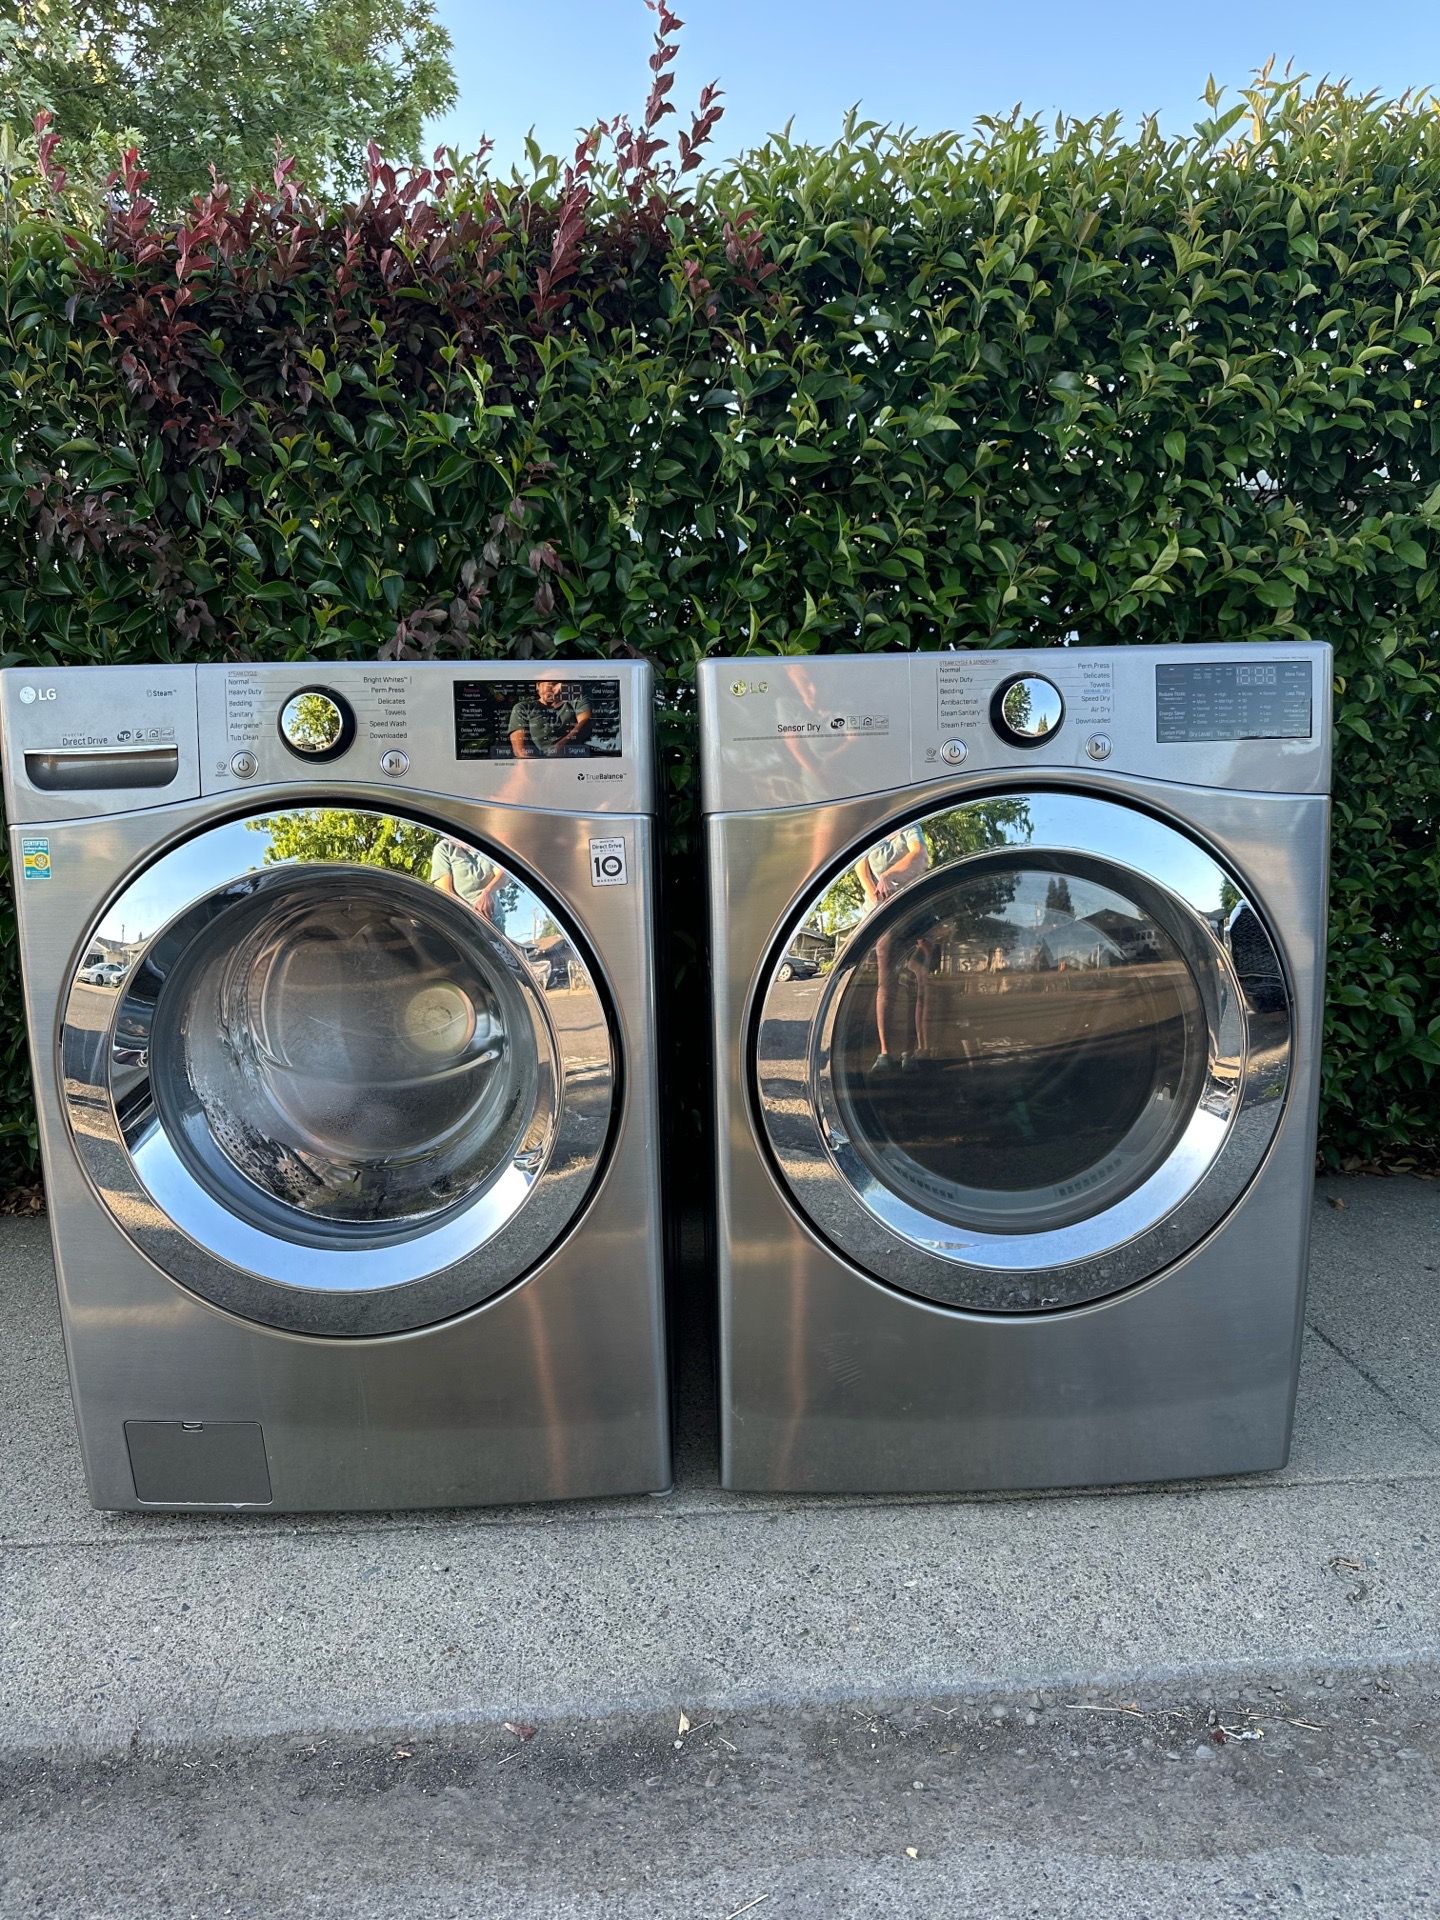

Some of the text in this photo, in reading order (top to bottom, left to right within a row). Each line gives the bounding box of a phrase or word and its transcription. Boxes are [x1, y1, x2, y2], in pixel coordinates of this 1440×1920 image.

[750, 681, 769, 693] LG
[38, 688, 56, 701] LG
[778, 723, 821, 733] Sensor Dry
[63, 736, 108, 746] Direct Drive
[594, 856, 622, 877] 10
